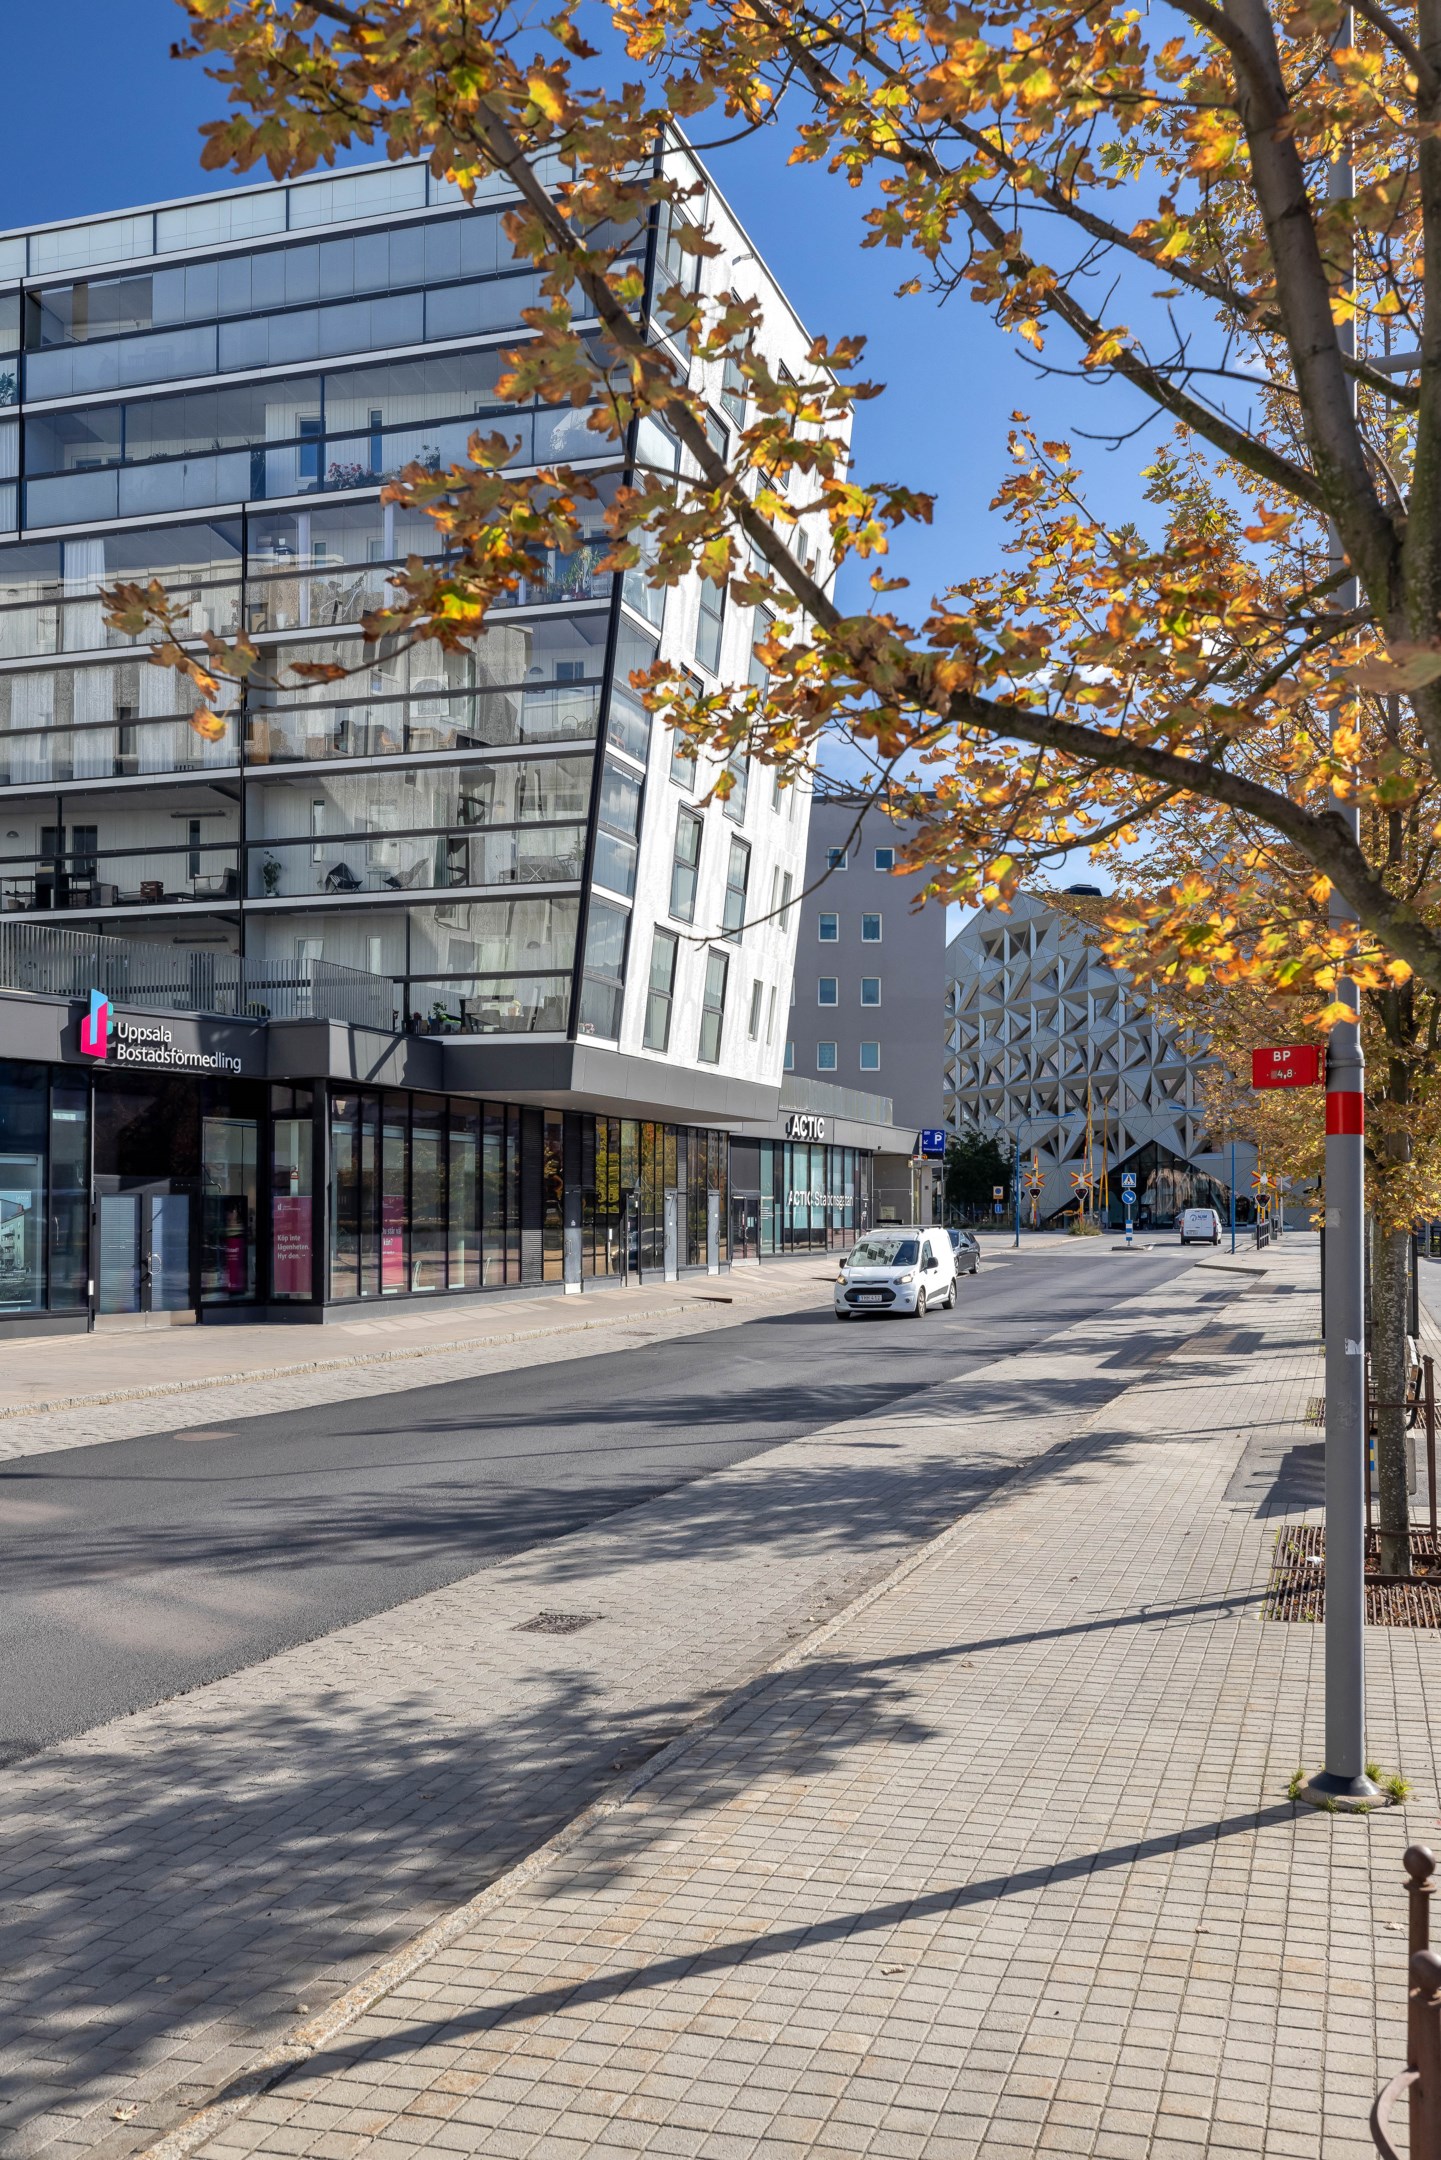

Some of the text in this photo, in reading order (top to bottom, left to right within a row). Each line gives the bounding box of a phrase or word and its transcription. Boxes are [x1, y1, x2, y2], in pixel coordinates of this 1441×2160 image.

[117, 1022, 172, 1043] Uppsala
[117, 1044, 242, 1074] Bostadsförmedling
[1273, 1050, 1291, 1062] BP
[792, 1114, 825, 1139] ACTIC
[934, 1135, 942, 1145] P
[788, 1190, 811, 1206] ACTIC
